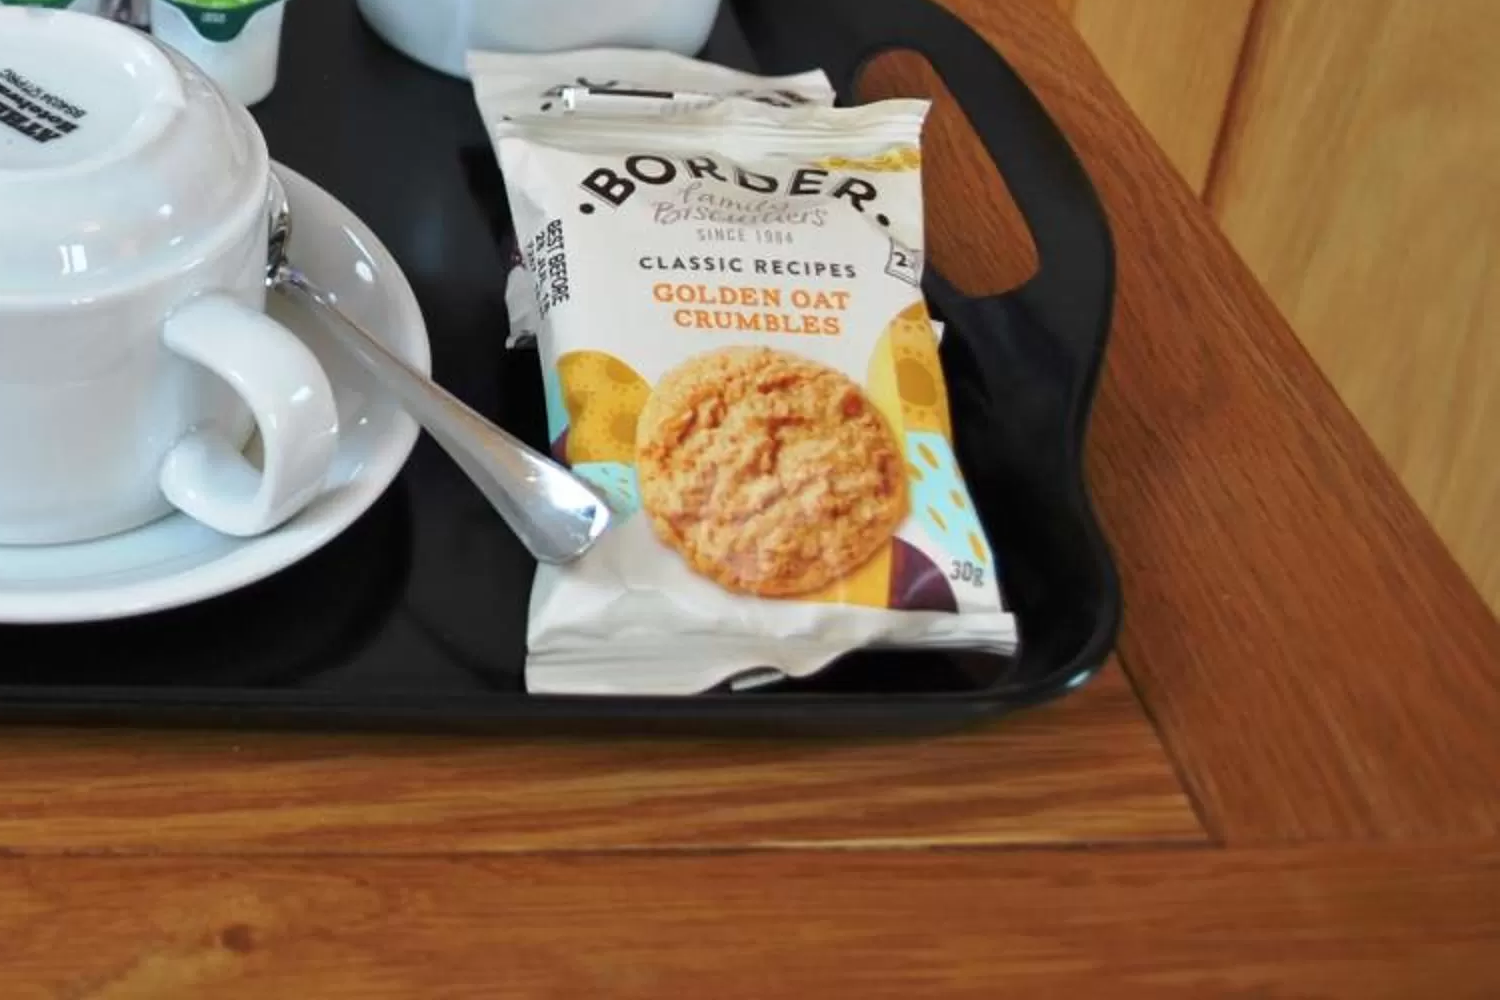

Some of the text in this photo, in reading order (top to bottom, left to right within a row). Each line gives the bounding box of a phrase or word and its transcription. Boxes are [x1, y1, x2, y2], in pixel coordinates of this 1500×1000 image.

[580, 155, 878, 213] BORDER
[696, 228, 745, 243] SINCE
[548, 253, 570, 307] BEFORE
[638, 256, 857, 279] CLASSIC RECIPES
[652, 282, 852, 311] GOLDEN OAT
[672, 308, 842, 336] CRUMBLES
[949, 559, 985, 588] 30g
